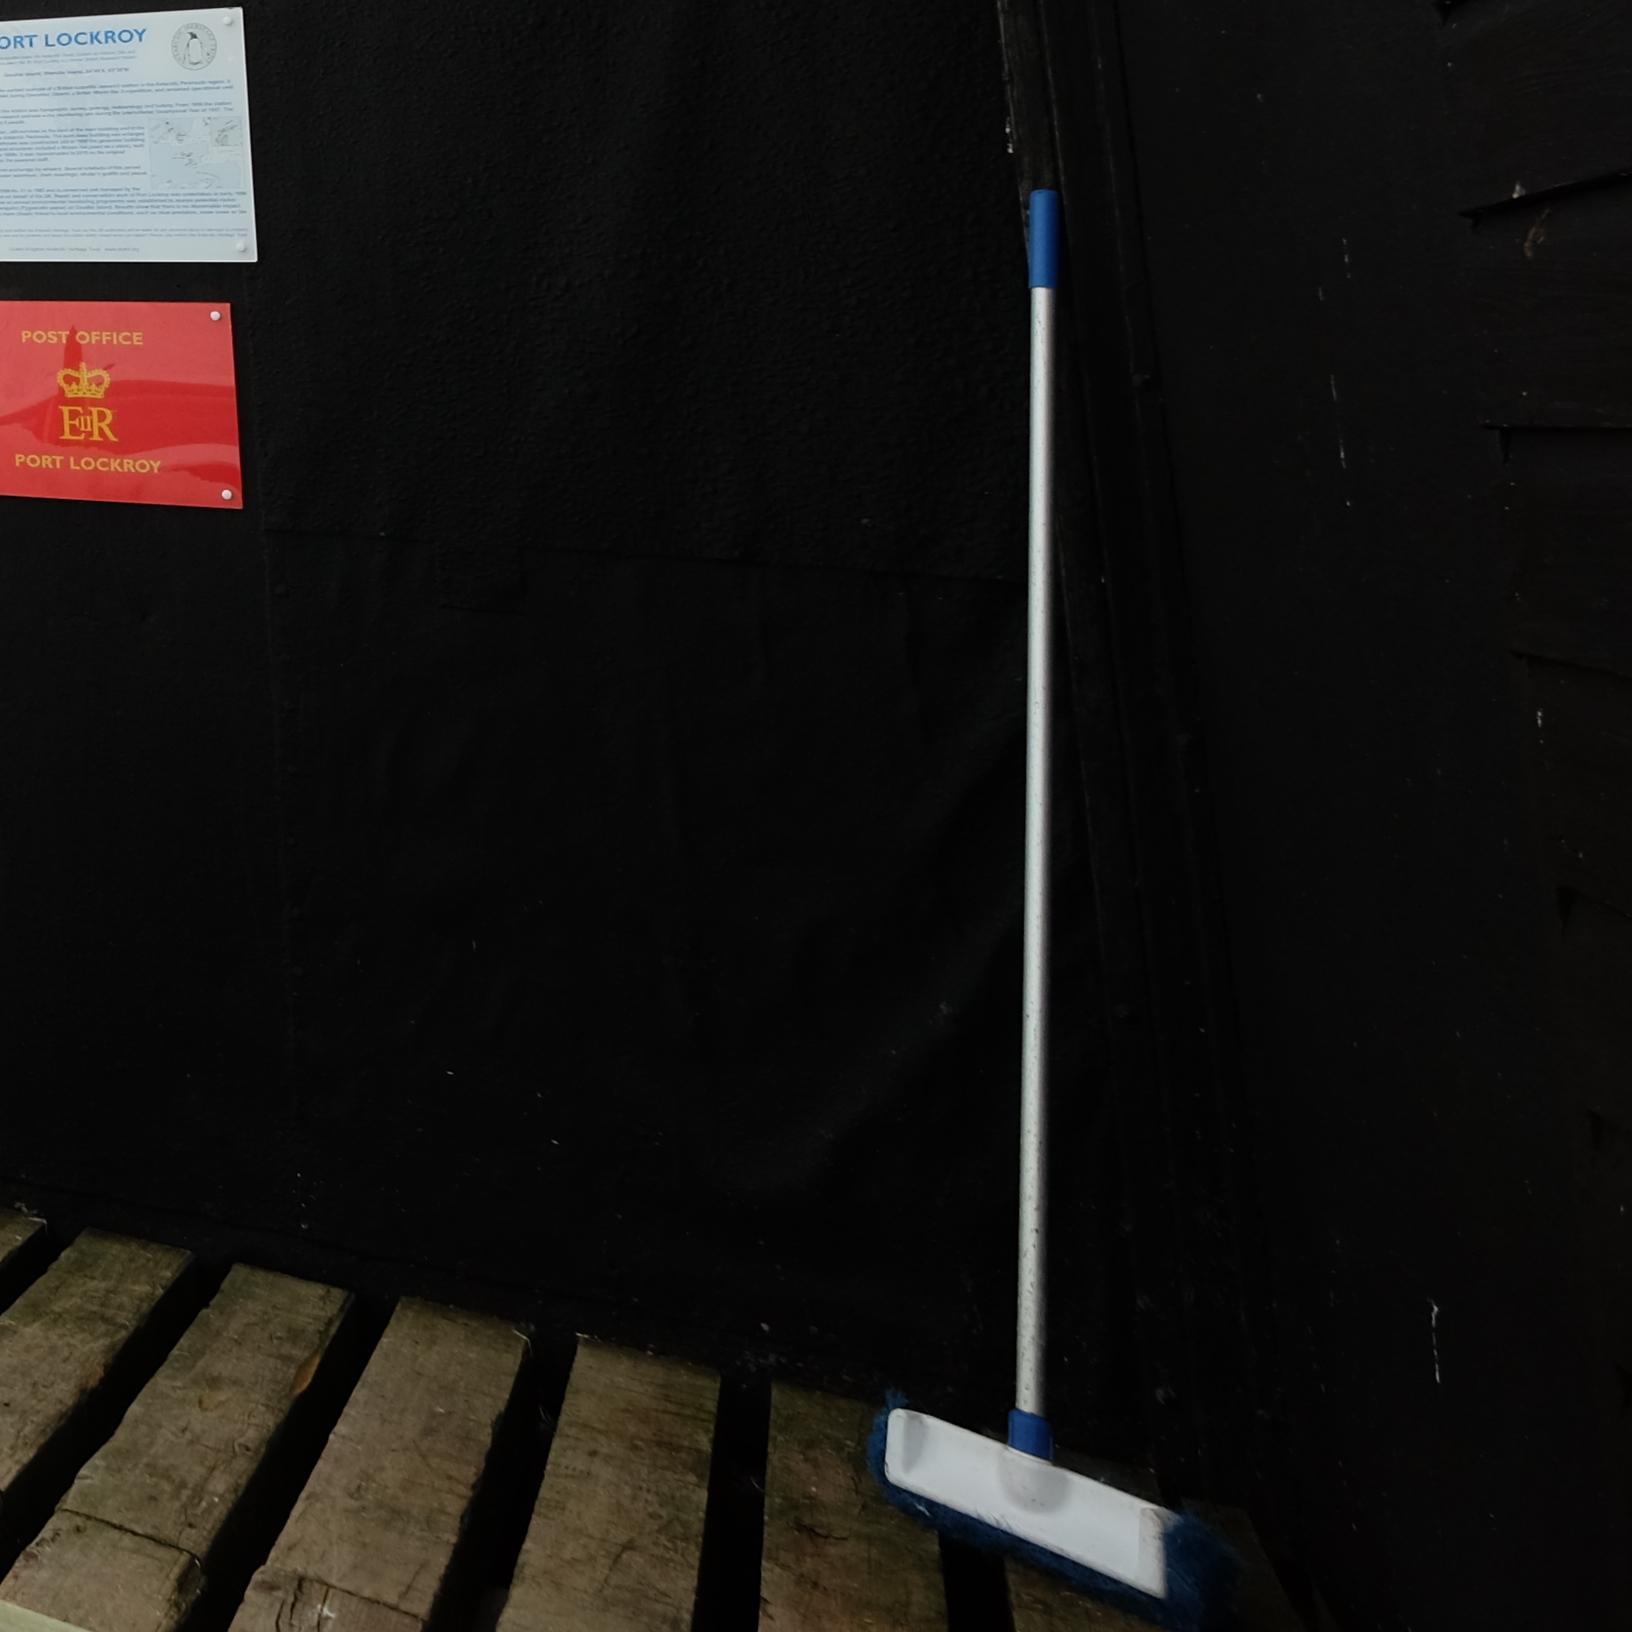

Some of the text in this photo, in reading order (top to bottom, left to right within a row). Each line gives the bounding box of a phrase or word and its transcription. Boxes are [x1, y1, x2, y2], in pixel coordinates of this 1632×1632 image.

[44, 28, 147, 48] LOCKROY
[21, 330, 144, 346] POST OFFICE
[14, 454, 162, 474] PORT LOCKROY
